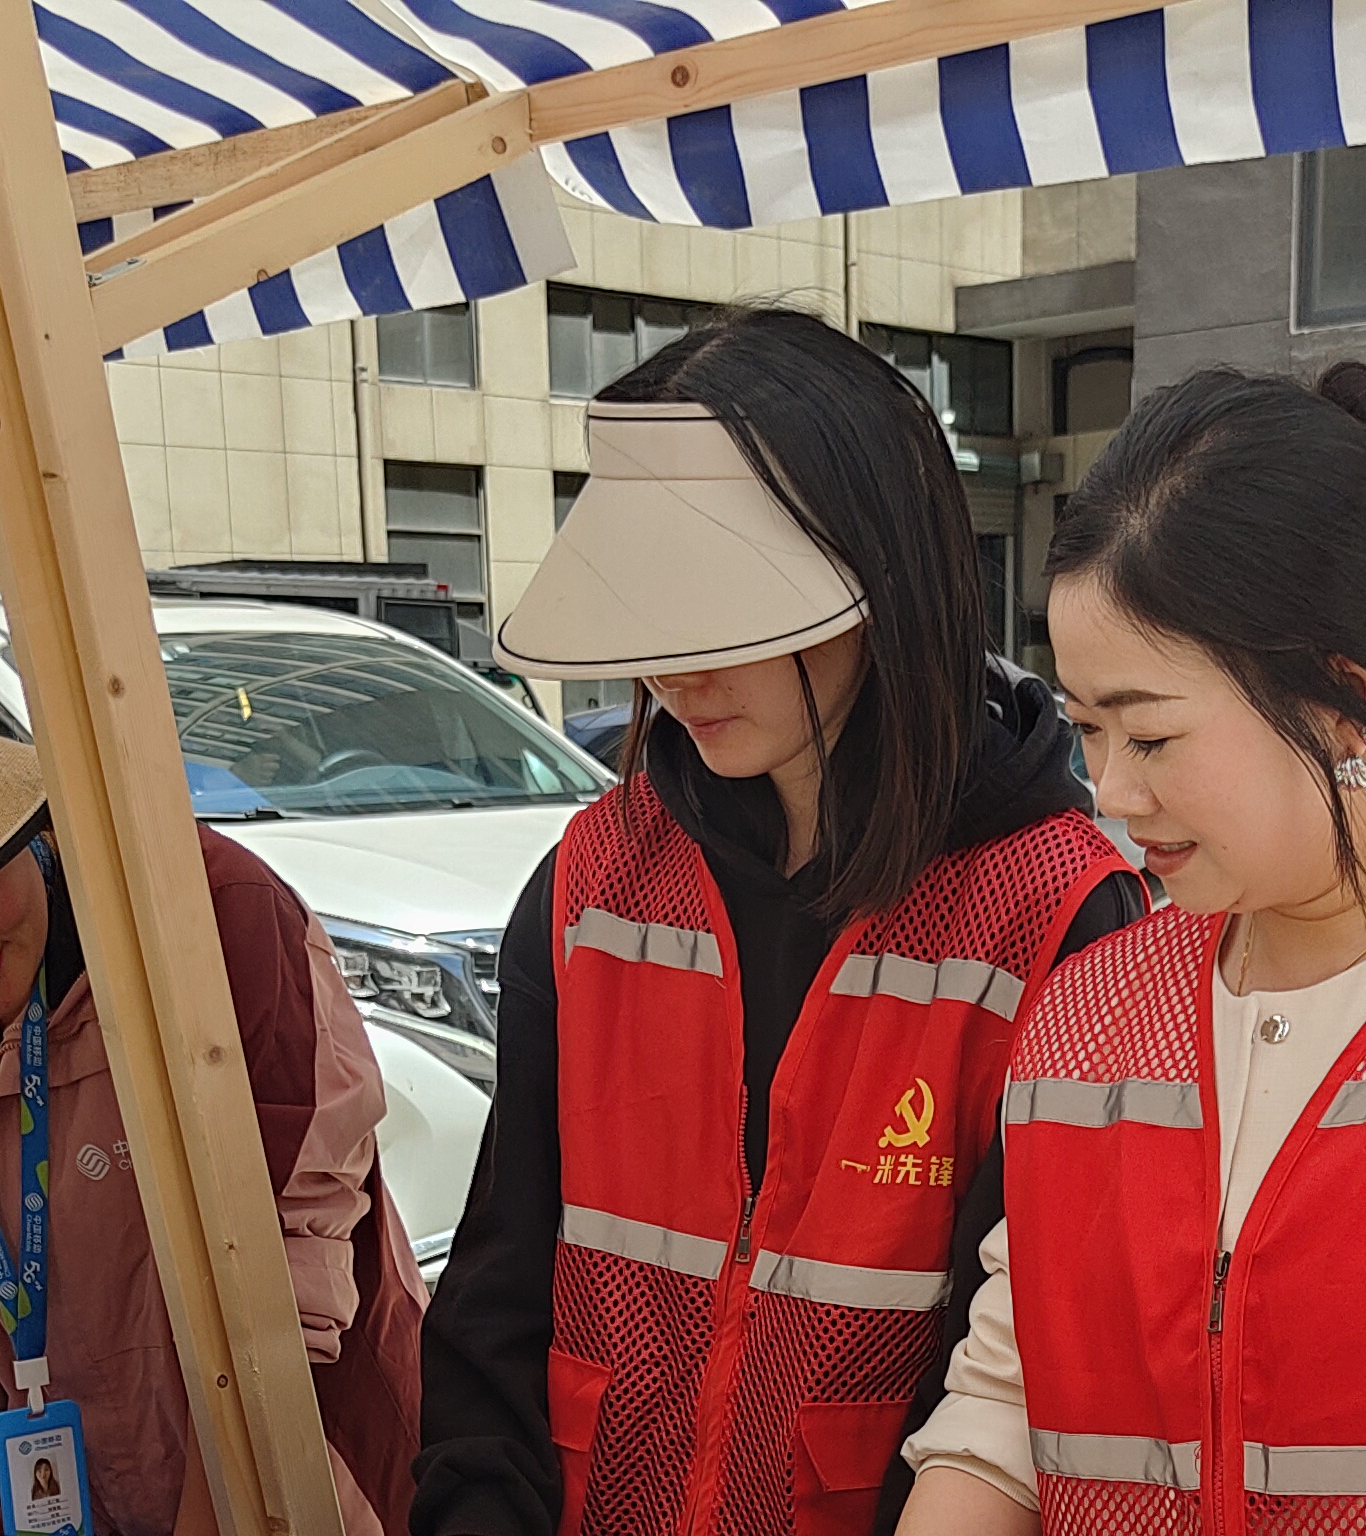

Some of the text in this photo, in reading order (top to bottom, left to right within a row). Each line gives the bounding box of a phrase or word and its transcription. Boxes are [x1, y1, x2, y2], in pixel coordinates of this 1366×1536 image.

[32, 1025, 43, 1067] 中国移动
[839, 1153, 956, 1188] 一米先锋
[32, 1214, 43, 1254] 中国移动
